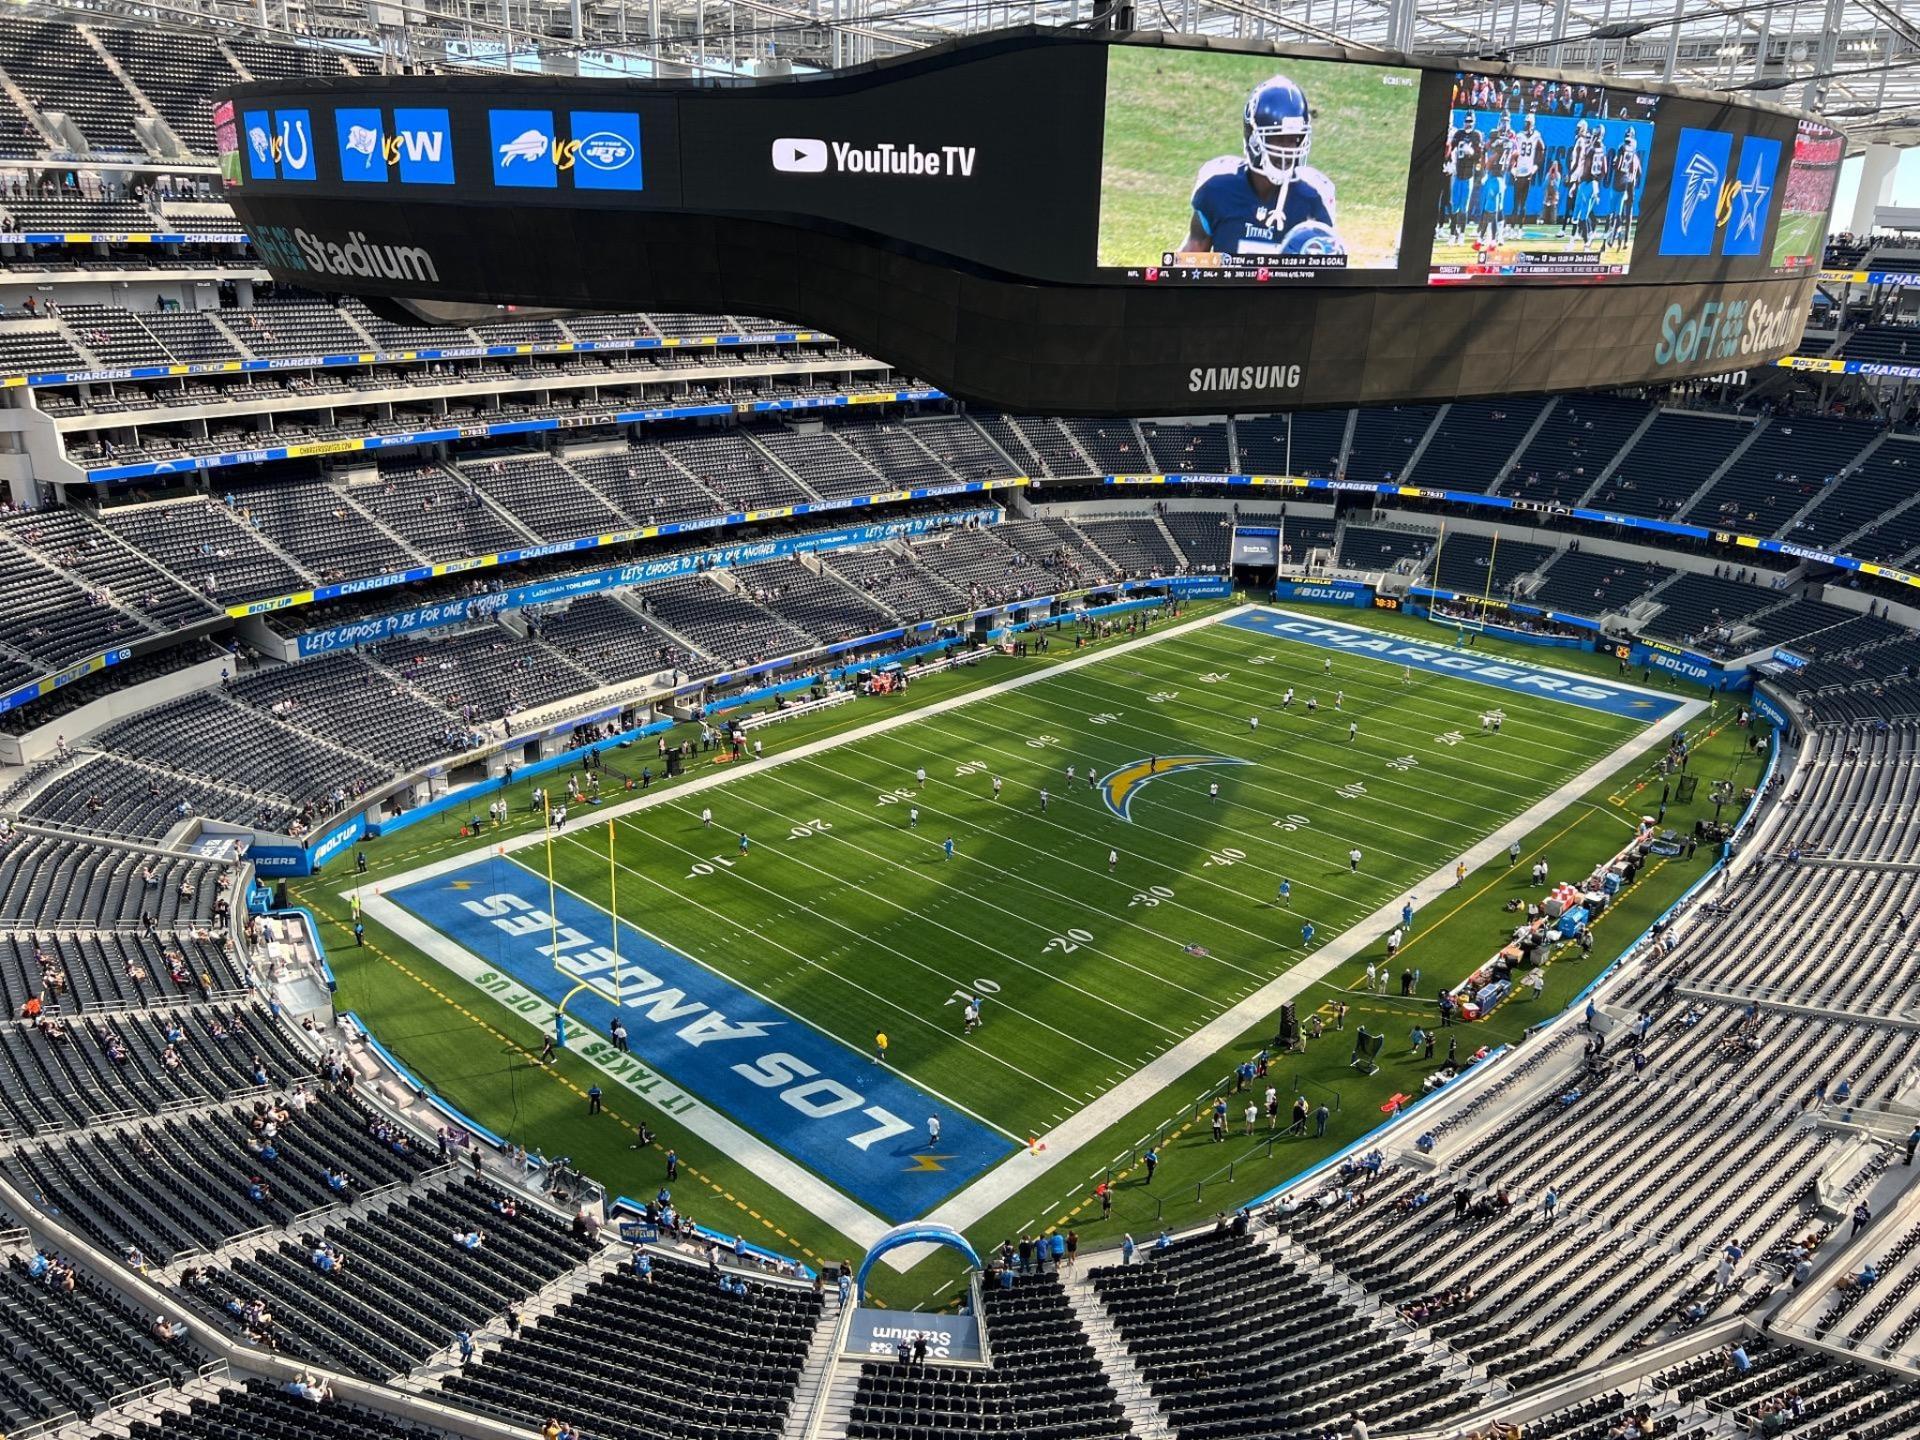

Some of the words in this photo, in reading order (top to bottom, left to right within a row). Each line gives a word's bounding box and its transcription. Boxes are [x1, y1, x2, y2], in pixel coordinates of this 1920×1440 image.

[269, 135, 283, 163] VS
[381, 133, 404, 165] VS
[401, 131, 443, 162] W
[552, 136, 581, 170] VS
[586, 147, 627, 157] JETS
[832, 141, 939, 175] YouTube
[942, 146, 976, 176] TV
[1715, 176, 1741, 228] VS
[184, 235, 242, 243] CHARGERS
[1244, 222, 1275, 240] TITANS
[295, 228, 439, 282] Stadium
[1233, 256, 1245, 264] TEN
[1257, 256, 1264, 265] 13
[1326, 257, 1344, 266] GOAL
[1655, 301, 1724, 365] SoFi
[441, 349, 488, 358] CHARGERS
[593, 340, 635, 349] CHARGERS
[269, 358, 324, 368] CHARGERS
[66, 370, 131, 382] CHARGERS
[1188, 365, 1300, 392] SAMSUNG
[1181, 476, 1229, 484] CHARGERS
[1327, 481, 1378, 492] CHARGERS
[926, 484, 966, 496] CHARGERS
[808, 500, 852, 512] CHARGERS
[679, 516, 728, 532] CHARGERS
[519, 541, 576, 559] CHARGERS
[1780, 544, 1835, 564] CHARGERS
[446, 562, 467, 573] BOLT
[469, 559, 482, 569] UP
[621, 567, 643, 582] LET'S
[645, 561, 678, 576] CHOOSE
[681, 559, 690, 568] TO
[743, 544, 776, 560] ANOTHER
[340, 573, 406, 594] CHARGERS
[566, 579, 600, 590] TOMLINSON
[1879, 568, 1898, 580] BOLT
[1899, 573, 1910, 583] UP
[1294, 587, 1355, 600] #BOLTUP
[248, 600, 276, 614] BOLT
[277, 597, 293, 609] UP
[306, 631, 336, 650] LET'S
[339, 621, 382, 643] CHOOSE
[386, 616, 399, 630] TO
[401, 613, 416, 629] BE
[420, 607, 438, 623] FOR
[443, 604, 462, 617] ONE
[1641, 639, 1653, 647] LOS
[1653, 643, 1681, 655] ANGELES
[1273, 621, 1619, 700] CHARGERS
[1649, 653, 1708, 678] #BOLTUP
[1026, 735, 1059, 748] 50
[956, 761, 988, 777] 40
[878, 787, 917, 806] 30
[788, 818, 833, 839] 20
[1272, 814, 1310, 832] 50
[315, 824, 357, 858] #BOLTUP
[690, 854, 737, 878] 10
[1209, 847, 1247, 866] 40
[1132, 885, 1175, 907] 30
[1048, 928, 1094, 954] 20
[460, 893, 789, 1048] ANGELES
[475, 972, 511, 993] US
[950, 978, 1000, 1002] 10
[504, 994, 542, 1013] OF
[582, 1042, 661, 1094] TAKES
[658, 1094, 696, 1114] IT
[730, 1052, 915, 1152] LOS
